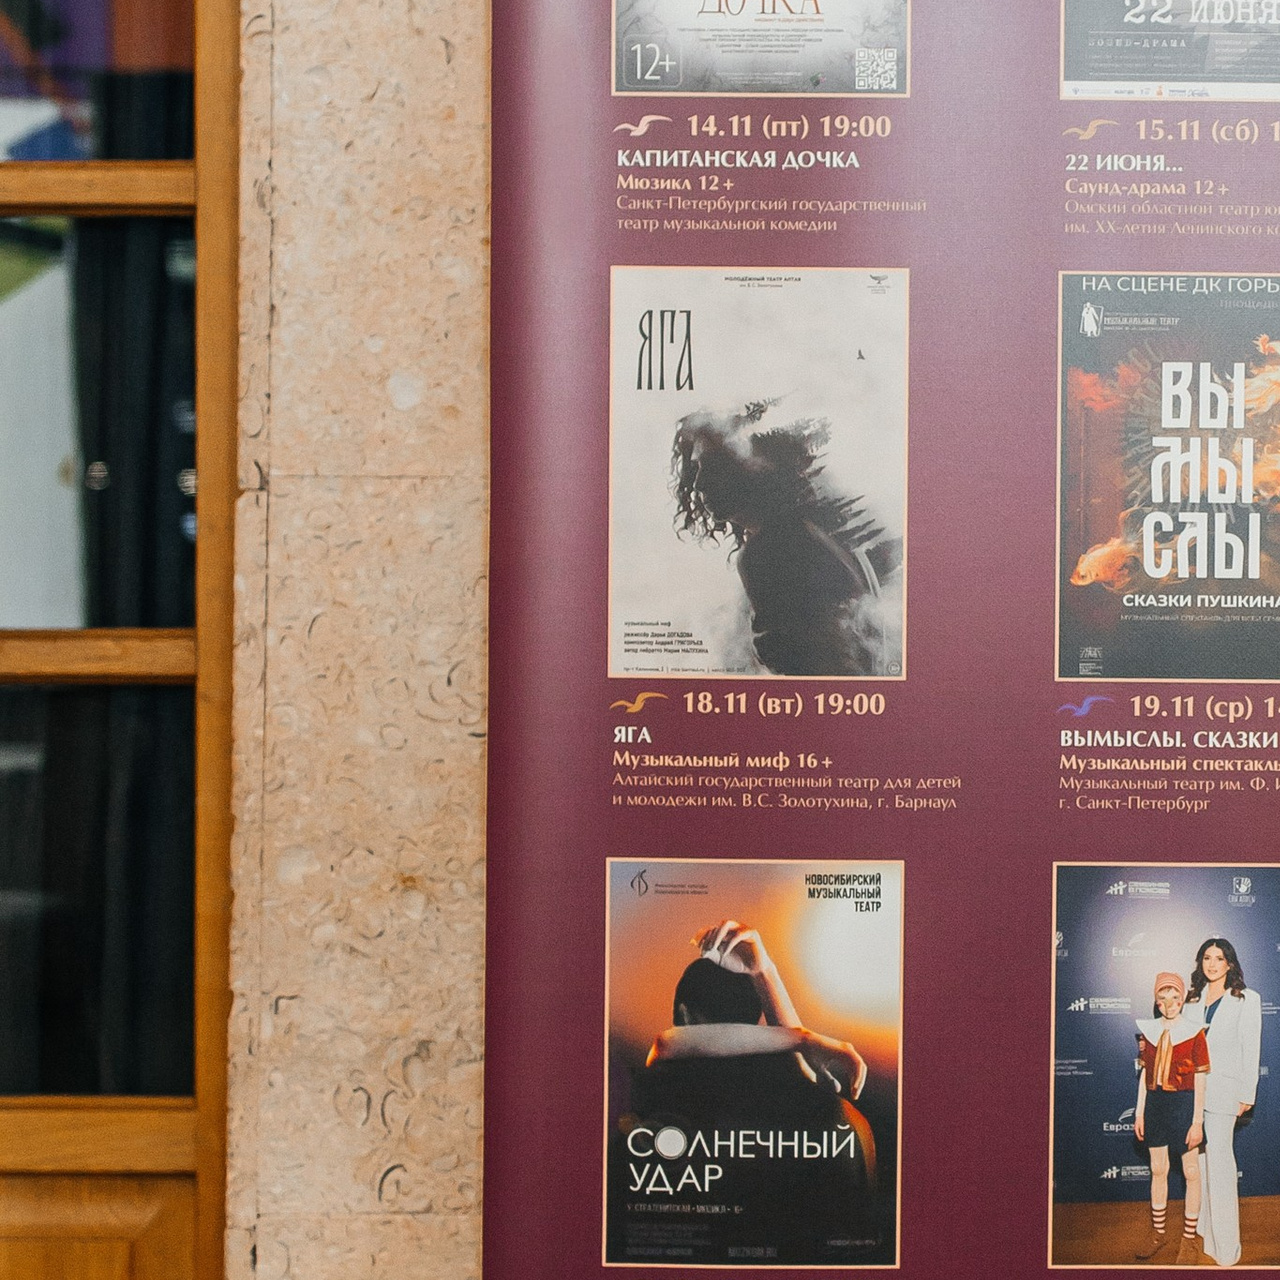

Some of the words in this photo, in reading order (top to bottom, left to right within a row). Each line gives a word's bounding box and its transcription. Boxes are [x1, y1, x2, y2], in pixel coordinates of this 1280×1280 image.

[630, 42, 676, 80] 12+
[688, 114, 750, 136] 14.11
[763, 115, 808, 139] (пт)
[821, 116, 891, 137] 19:00
[1137, 120, 1199, 140] 15.11
[1212, 119, 1258, 144] (сб)
[618, 150, 776, 167] КАПИТАНСКАЯ
[782, 151, 860, 170] ДОЧКА
[1066, 154, 1088, 170] 22
[1097, 154, 1182, 171] ИЮНЯ...
[636, 310, 694, 391] ЯГА
[1123, 594, 1191, 607] СКАЗКИ
[684, 692, 746, 713] 18.11
[759, 692, 802, 717] (вт)
[815, 693, 885, 715] 19:00
[1131, 696, 1193, 716] 19.11
[1206, 696, 1252, 723] (ср)
[614, 726, 651, 743] ЯГА
[1061, 730, 1186, 747] ВЫМЫСЛЫ.
[1193, 731, 1278, 748] СКАЗКИ
[613, 750, 739, 770] Музыкальный
[746, 751, 790, 772] миф
[613, 772, 693, 786] Алтайский
[699, 776, 832, 790] государственный
[838, 778, 879, 791] театр
[884, 778, 911, 789] для
[916, 777, 961, 789] детей
[613, 795, 622, 805] и
[627, 796, 706, 807] молодежи
[712, 797, 736, 806] им.
[779, 794, 872, 811] Золотухина,
[878, 798, 888, 808] г.
[895, 795, 956, 811] Барнаул
[805, 873, 882, 886] НОВОСИБИРСКИЙ
[808, 886, 882, 900] МУЗЫКАЛЬНЫЙ
[854, 901, 882, 912] ТЕАТР
[627, 1124, 855, 1159] СОЛНЕЧНЫЙ
[629, 1164, 723, 1195] УДАР
